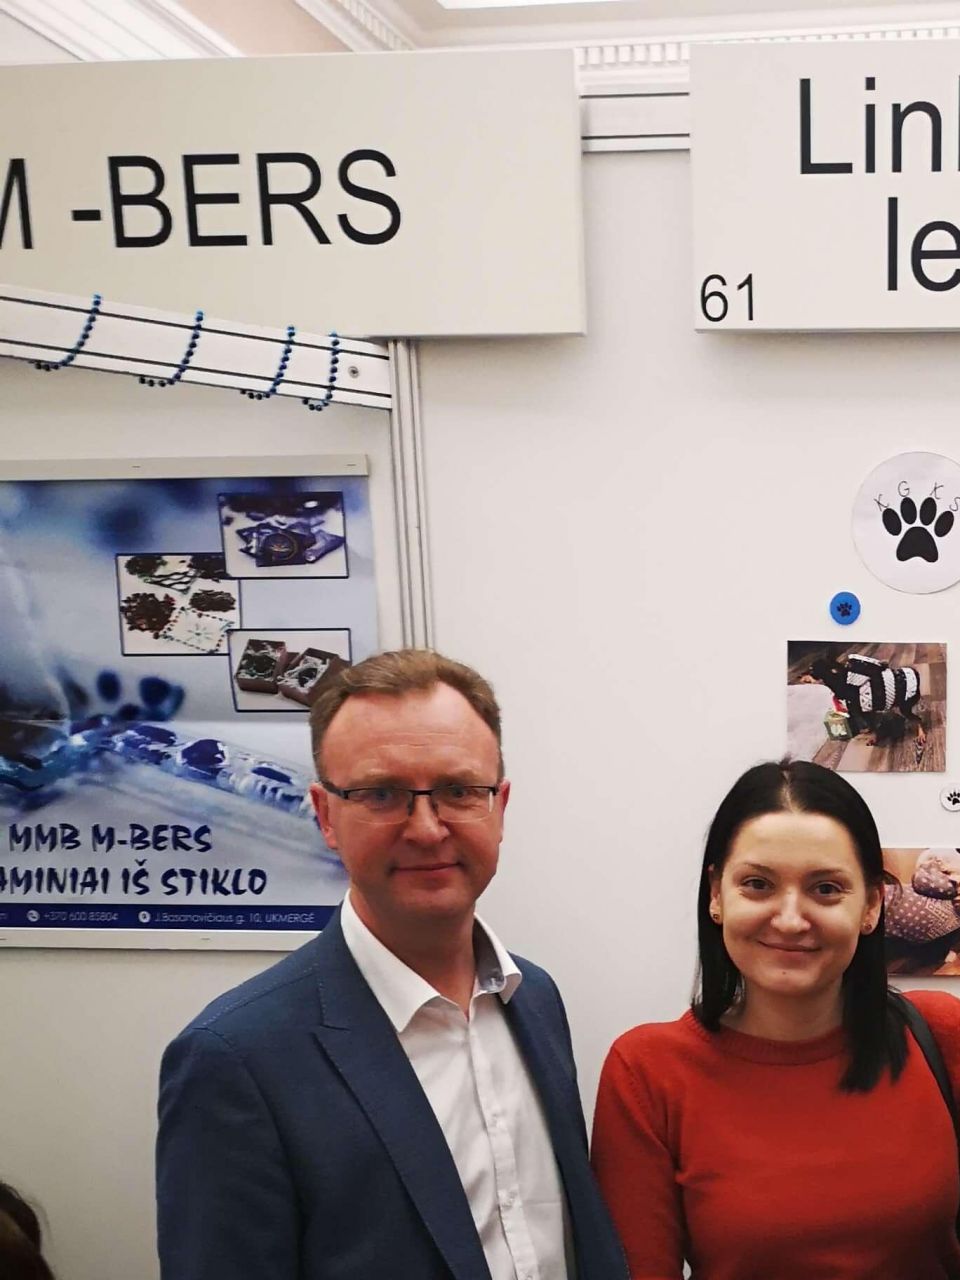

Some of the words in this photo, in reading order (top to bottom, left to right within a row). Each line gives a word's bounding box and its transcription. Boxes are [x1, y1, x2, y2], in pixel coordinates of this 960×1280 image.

[699, 273, 757, 323] 61
[8, 823, 82, 853] MMB
[91, 823, 213, 853] M-BERS
[121, 858, 151, 896] IŠ
[160, 866, 268, 897] STIKLO
